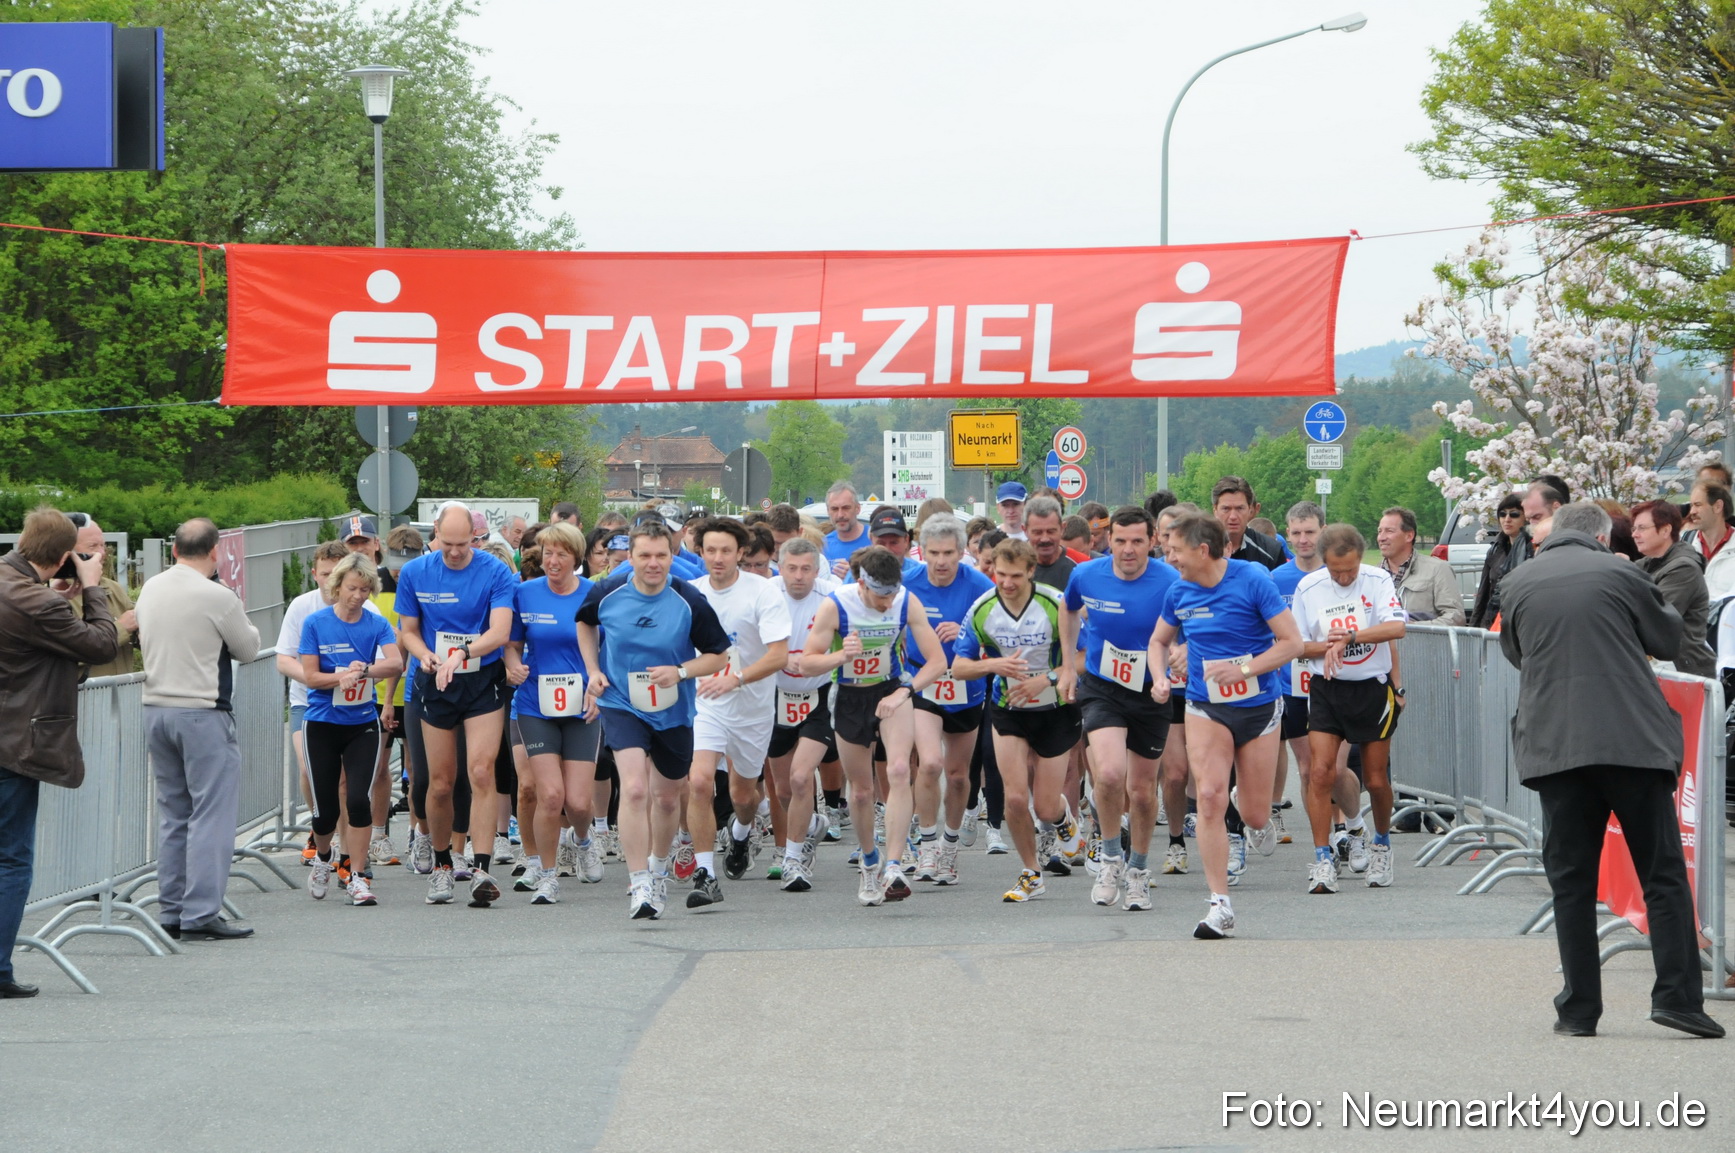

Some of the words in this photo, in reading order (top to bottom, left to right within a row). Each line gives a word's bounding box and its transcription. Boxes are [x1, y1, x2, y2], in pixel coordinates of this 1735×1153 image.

[958, 433, 1012, 446] Neumarkt
[1061, 437, 1079, 453] 60
[898, 469, 910, 482] SHB
[1325, 604, 1346, 614] MEYER
[1110, 646, 1129, 658] MEYER
[853, 657, 880, 676] 92
[1112, 658, 1132, 684] 16
[933, 680, 955, 701] 73
[1300, 671, 1311, 693] 6
[554, 687, 566, 712] 9
[647, 684, 657, 707] 1
[786, 702, 811, 723] 59
